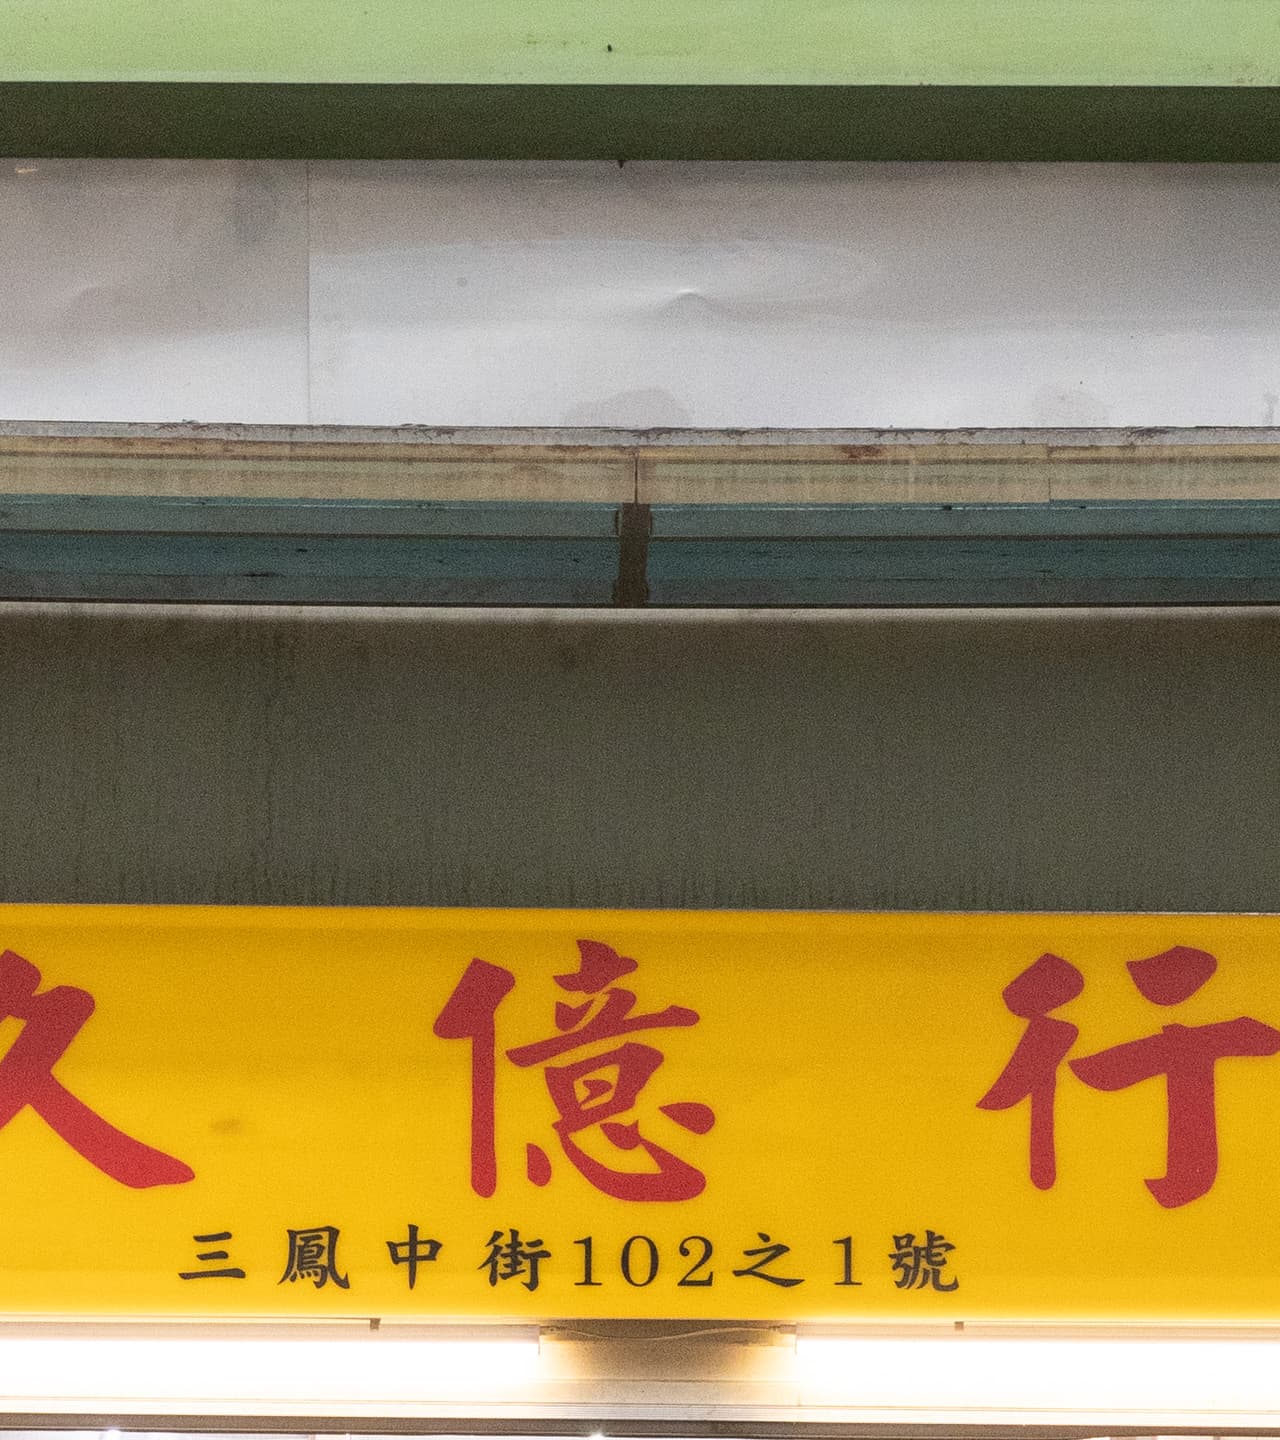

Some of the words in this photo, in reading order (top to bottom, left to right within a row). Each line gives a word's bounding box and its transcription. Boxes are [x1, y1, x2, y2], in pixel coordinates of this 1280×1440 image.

[176, 1222, 963, 1297] 三鳳中街102之1號
